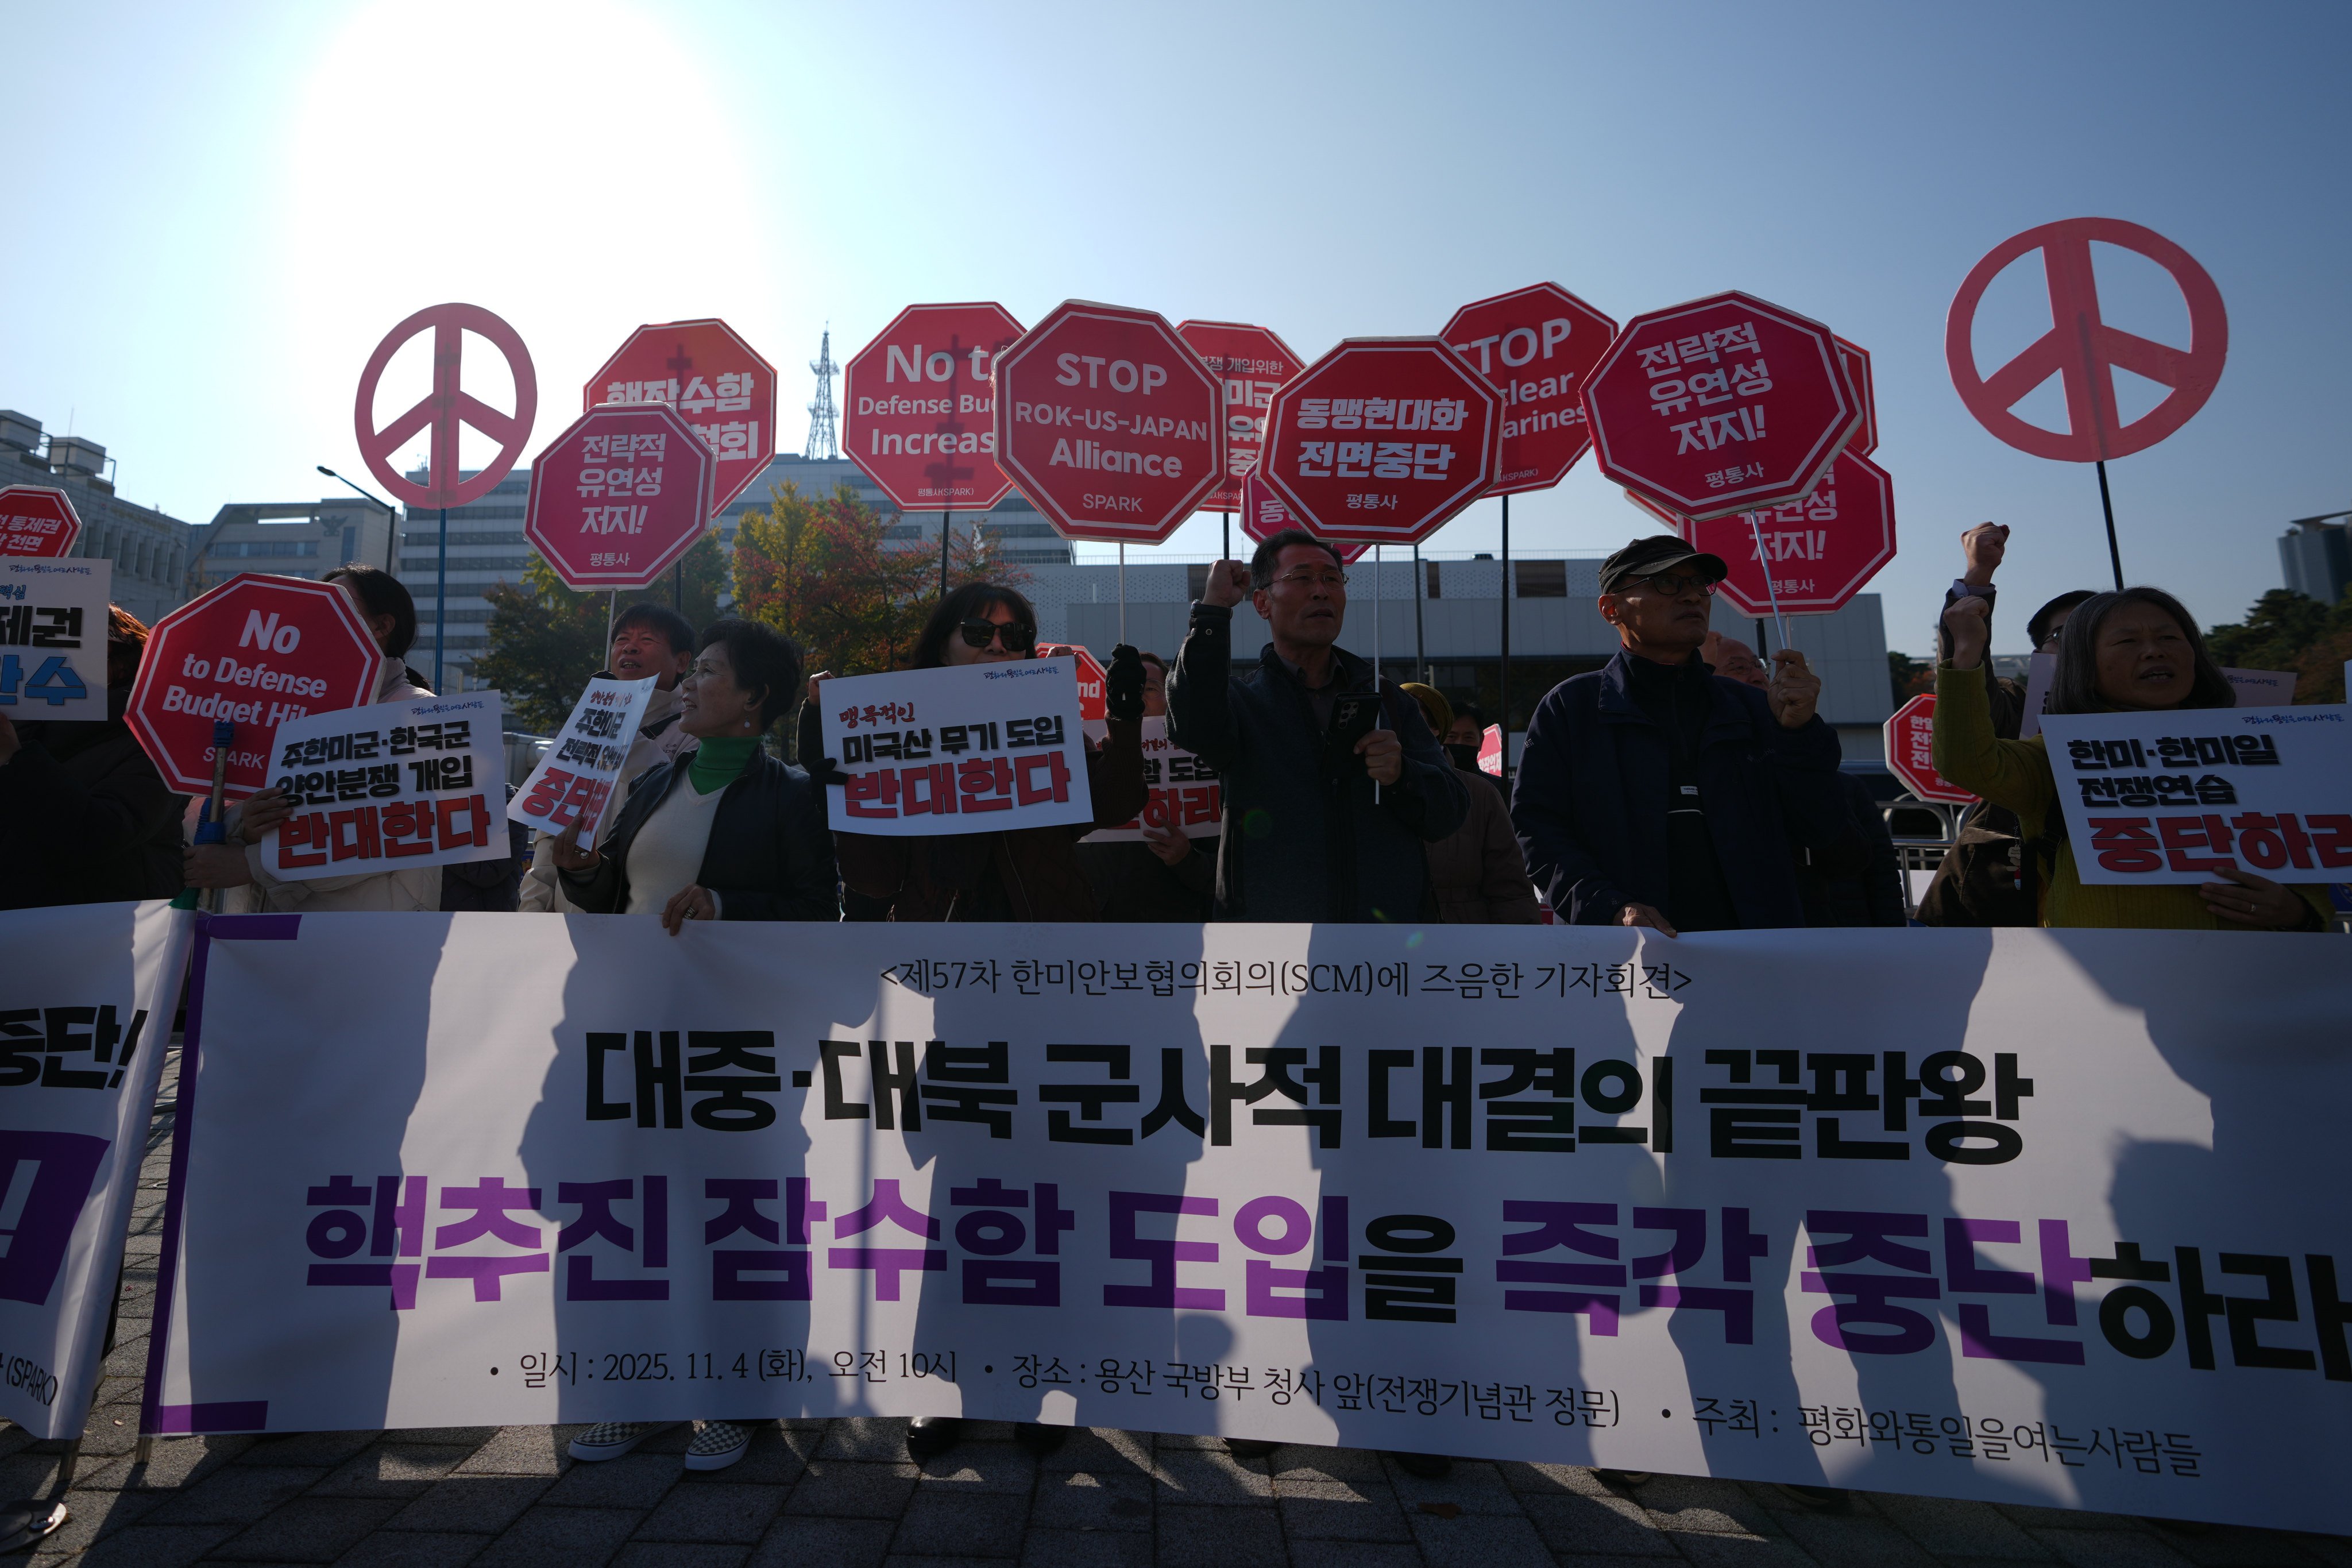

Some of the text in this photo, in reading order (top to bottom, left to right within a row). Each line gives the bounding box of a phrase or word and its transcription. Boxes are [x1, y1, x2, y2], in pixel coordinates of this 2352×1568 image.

[886, 344, 1000, 383] No t
[1227, 357, 1283, 375] 개입위한
[1636, 322, 1761, 379] 전략적
[1055, 353, 1167, 395] STOP
[1650, 358, 1772, 417] 유연성
[858, 395, 994, 415] Defense Bu
[1221, 378, 1281, 408] 미군
[1015, 401, 1207, 441] ROK-US-JAPAN
[1297, 397, 1469, 431] 동맹현대화
[1502, 404, 1588, 438] arines
[1670, 404, 1766, 455] 저지!
[582, 433, 667, 463] 전략적
[1048, 438, 1183, 478] Alliance
[1297, 441, 1455, 481] 전면중단
[576, 467, 662, 498] 유연성
[1705, 462, 1764, 488] 평통사
[580, 504, 648, 535] 저지!
[1083, 493, 1143, 513] SPARK
[1346, 493, 1397, 510] 평통사
[7, 515, 62, 535] 통제권
[7, 534, 44, 551] 전면
[589, 553, 630, 567] 평통사
[1748, 530, 1826, 562] 저지!
[0, 584, 26, 600] 핵심
[238, 609, 300, 654] No
[182, 653, 327, 698] to Defense
[162, 685, 263, 725] Budget
[839, 701, 915, 729] 맹목적인
[280, 720, 470, 767] 주한미군·한국군
[556, 737, 603, 768] 전략적
[842, 715, 1064, 764] 미국산 무기 도입
[2067, 734, 2280, 770] 한미·한미일
[203, 747, 266, 769] SARK
[275, 755, 472, 808] 양안분쟁 개입
[844, 751, 1071, 818] 반대한다
[2077, 775, 2237, 808] 전쟁연습
[279, 794, 491, 869] 반대한다
[880, 959, 1692, 999] <제57차 한미안보협의회의(SCM)에 즈음한 기자회견>
[586, 1030, 2034, 1165] 대중·대북 군사적 대결의 끝판왕
[306, 1175, 2352, 1382] 핵추진 잠수함 도입을 즉각 중단하라
[520, 1351, 577, 1388] 일시
[603, 1353, 675, 1381] 2025.
[687, 1353, 723, 1380] 11.
[732, 1351, 749, 1378] 4
[759, 1347, 813, 1384] (화),
[828, 1349, 887, 1383] 오전
[899, 1351, 956, 1383] 10시
[1012, 1354, 1072, 1389] 장소
[1094, 1358, 1156, 1396] 용산
[1163, 1362, 1255, 1401] 국방부
[1263, 1367, 1325, 1407] 청사
[1545, 1387, 1619, 1427] 정문)
[1692, 1397, 1760, 1439] 주최
[1798, 1405, 2202, 1478] 평화와통일을여는사람들
